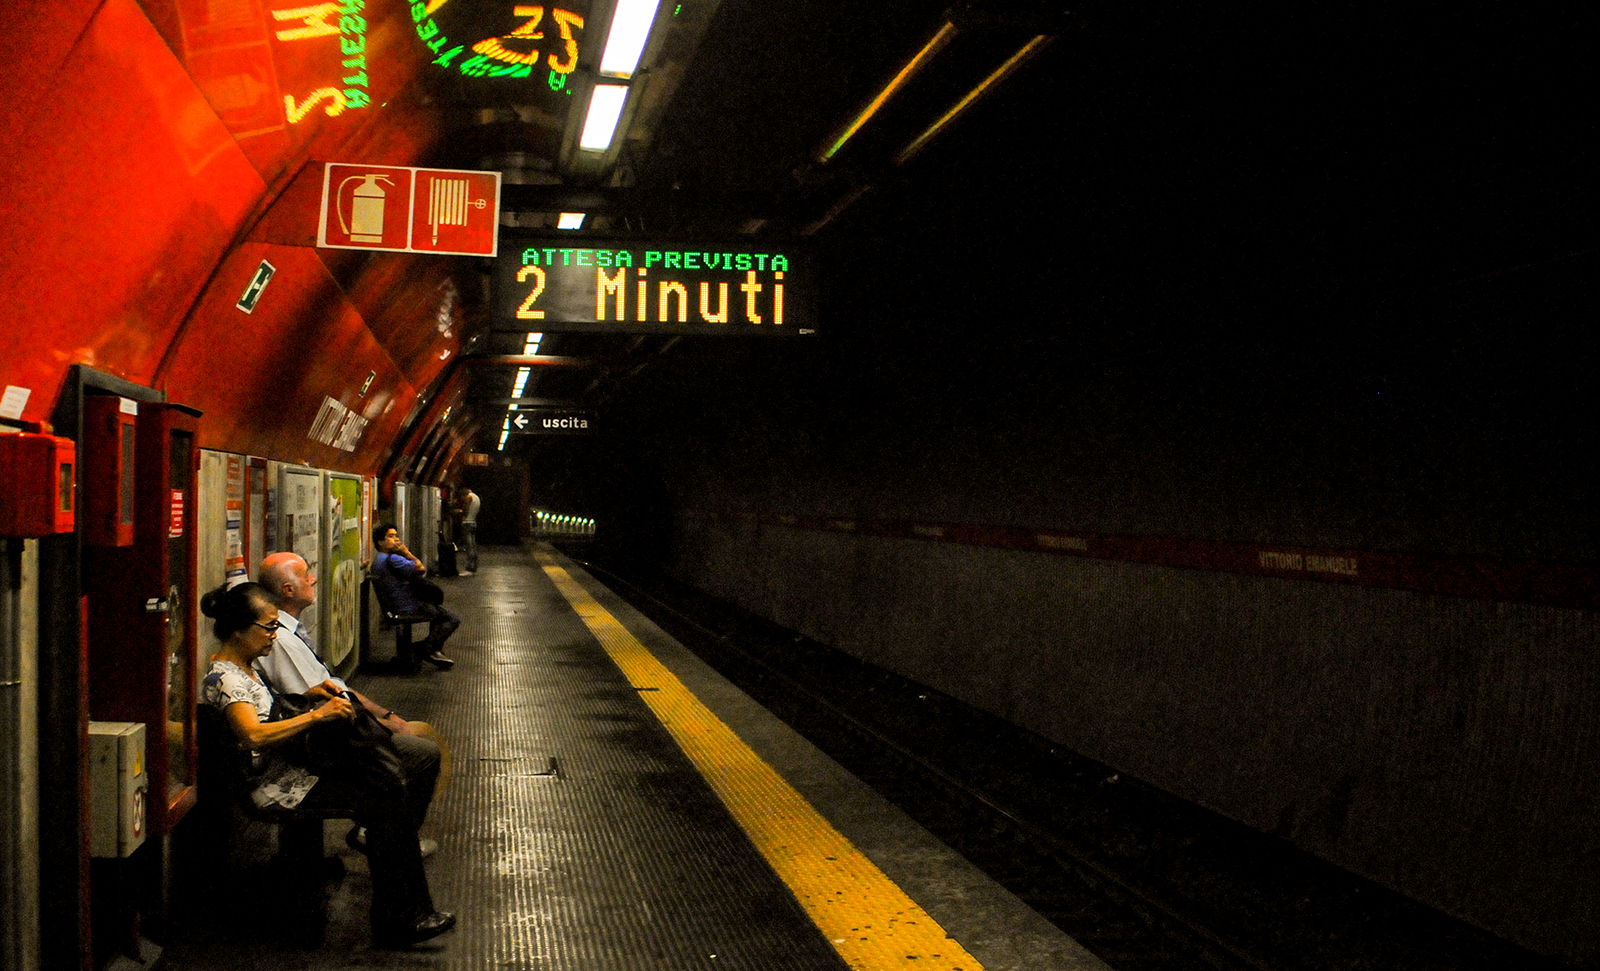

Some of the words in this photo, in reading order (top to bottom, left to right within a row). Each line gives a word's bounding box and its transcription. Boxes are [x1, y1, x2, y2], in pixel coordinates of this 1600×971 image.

[521, 247, 633, 268] ATTESA
[644, 250, 789, 273] PREVISTA
[515, 264, 547, 320] 2
[595, 265, 785, 326] Minuti
[542, 416, 589, 429] uscita
[1259, 552, 1302, 571] VITTORIO
[1305, 555, 1359, 576] EMANUELE
